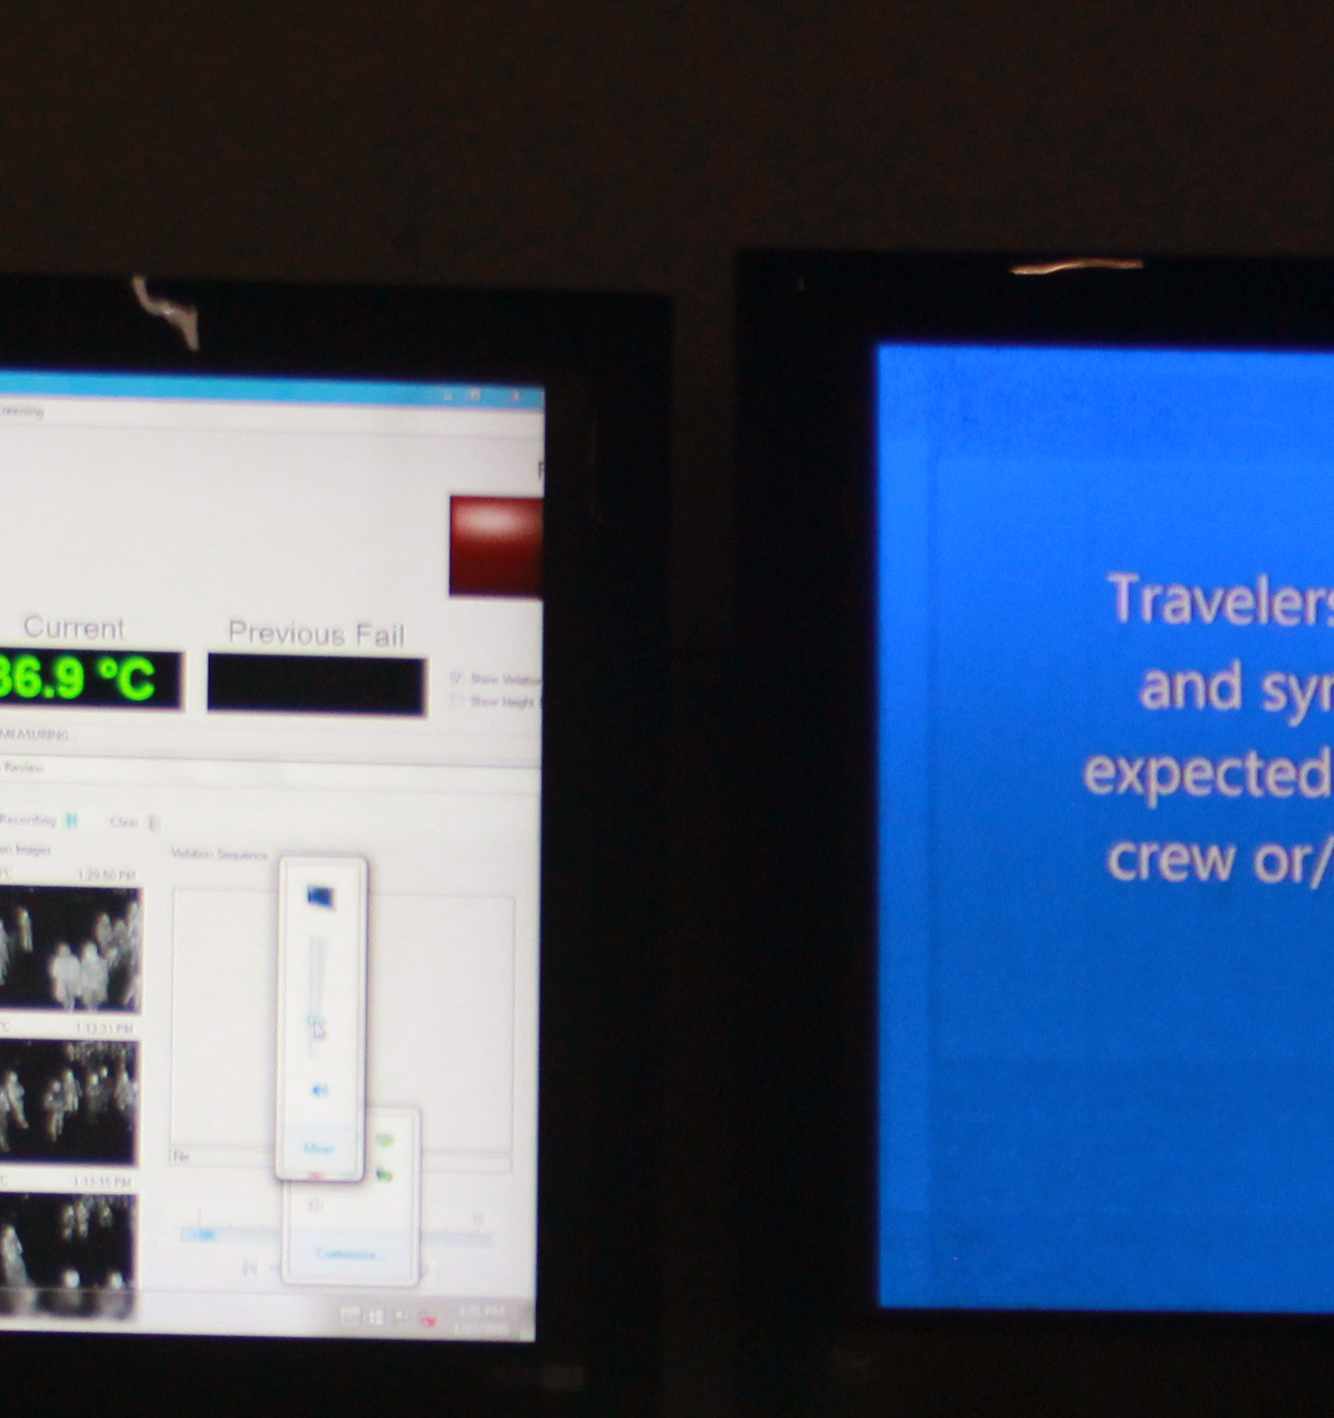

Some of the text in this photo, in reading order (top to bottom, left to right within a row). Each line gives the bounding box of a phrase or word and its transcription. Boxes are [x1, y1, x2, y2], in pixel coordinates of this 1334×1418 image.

[22, 614, 126, 641] Current
[228, 619, 407, 650] Previous Fail
[1139, 658, 1242, 711] and
[4, 760, 45, 774] Review
[1083, 746, 1332, 808] expected
[0, 812, 57, 831] Recording
[109, 815, 139, 829] Clear
[1107, 840, 1236, 882] crew
